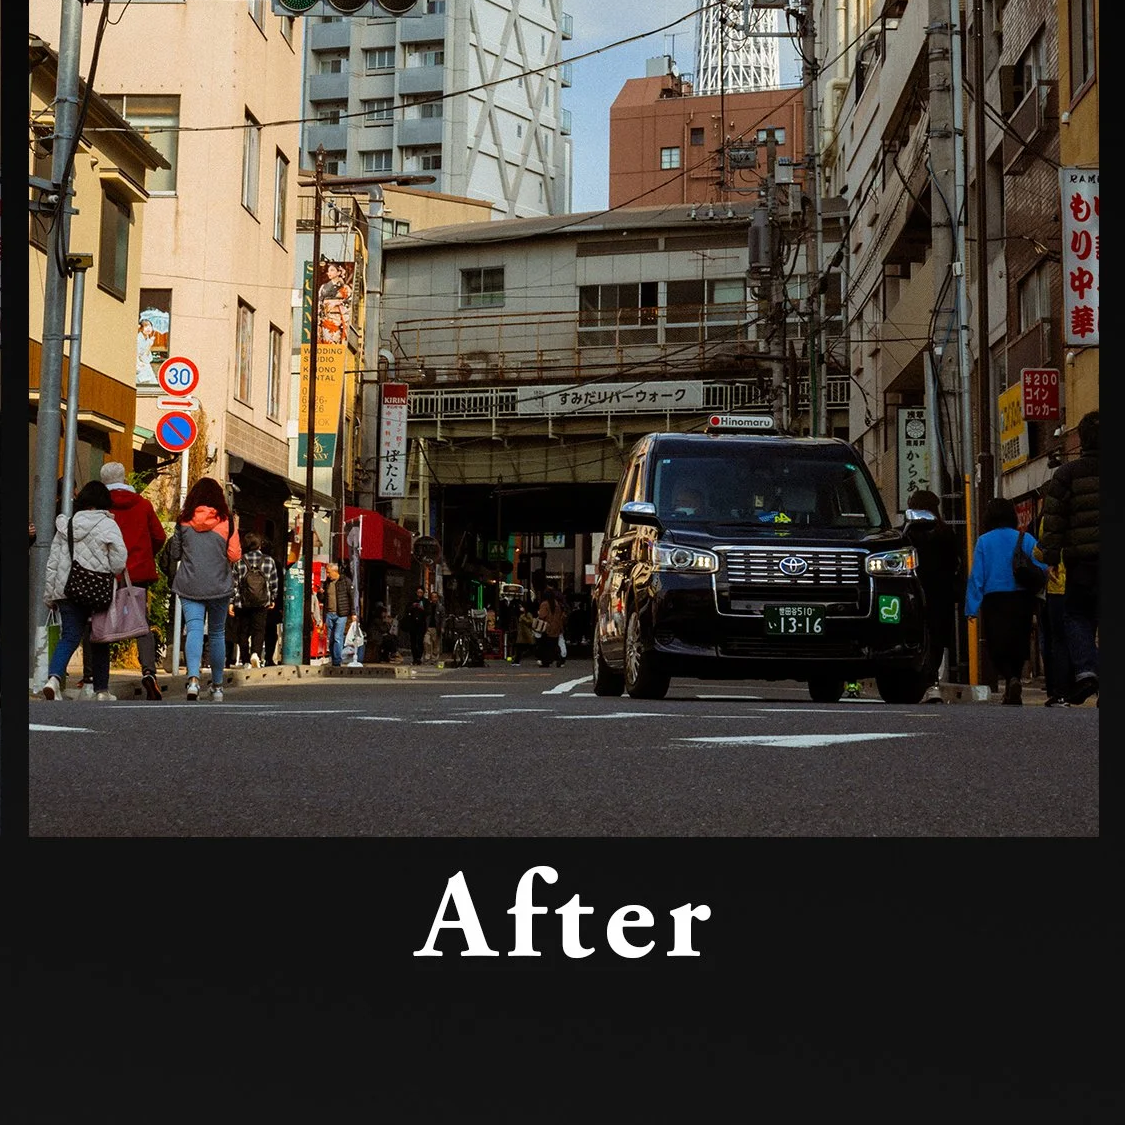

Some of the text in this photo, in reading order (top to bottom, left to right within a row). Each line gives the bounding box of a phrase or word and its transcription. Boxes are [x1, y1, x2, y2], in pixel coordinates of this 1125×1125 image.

[1070, 192, 1094, 338] もり中華
[303, 347, 343, 355] WDDING
[168, 367, 191, 385] 30
[1025, 373, 1057, 385] ¥200
[559, 389, 686, 405] すみだリバーウォーク
[1026, 388, 1049, 400] コイン
[301, 405, 324, 413] 226
[1026, 403, 1057, 415] ロッカー
[721, 417, 770, 427] Hinomaru
[781, 617, 821, 633] 13-16
